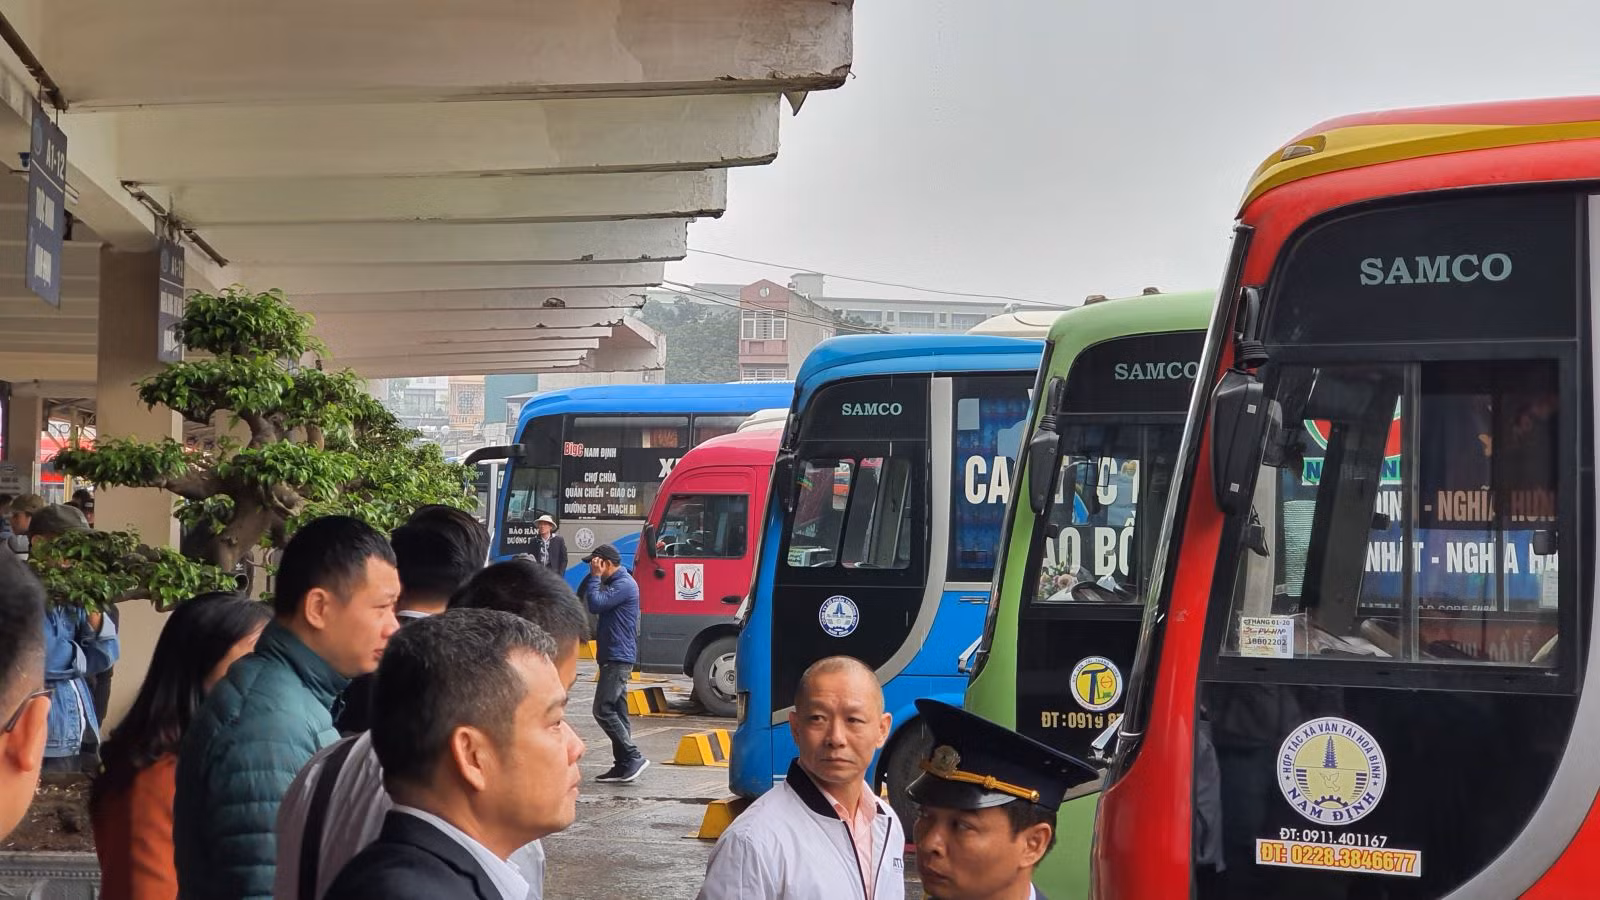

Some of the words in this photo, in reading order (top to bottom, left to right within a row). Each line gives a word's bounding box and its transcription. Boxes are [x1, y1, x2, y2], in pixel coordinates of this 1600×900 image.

[1360, 253, 1512, 285] SAMCO
[1114, 362, 1199, 380] SAMCO
[842, 402, 902, 416] SAMCO
[584, 447, 599, 458] NAM
[1288, 787, 1323, 819] NAM
[1332, 792, 1376, 821] ĐỊNH
[1279, 828, 1300, 841] ĐT:
[1302, 830, 1387, 848] 0911.401167
[1260, 842, 1287, 863] ĐT:
[1291, 845, 1416, 873] 0228.3846677
